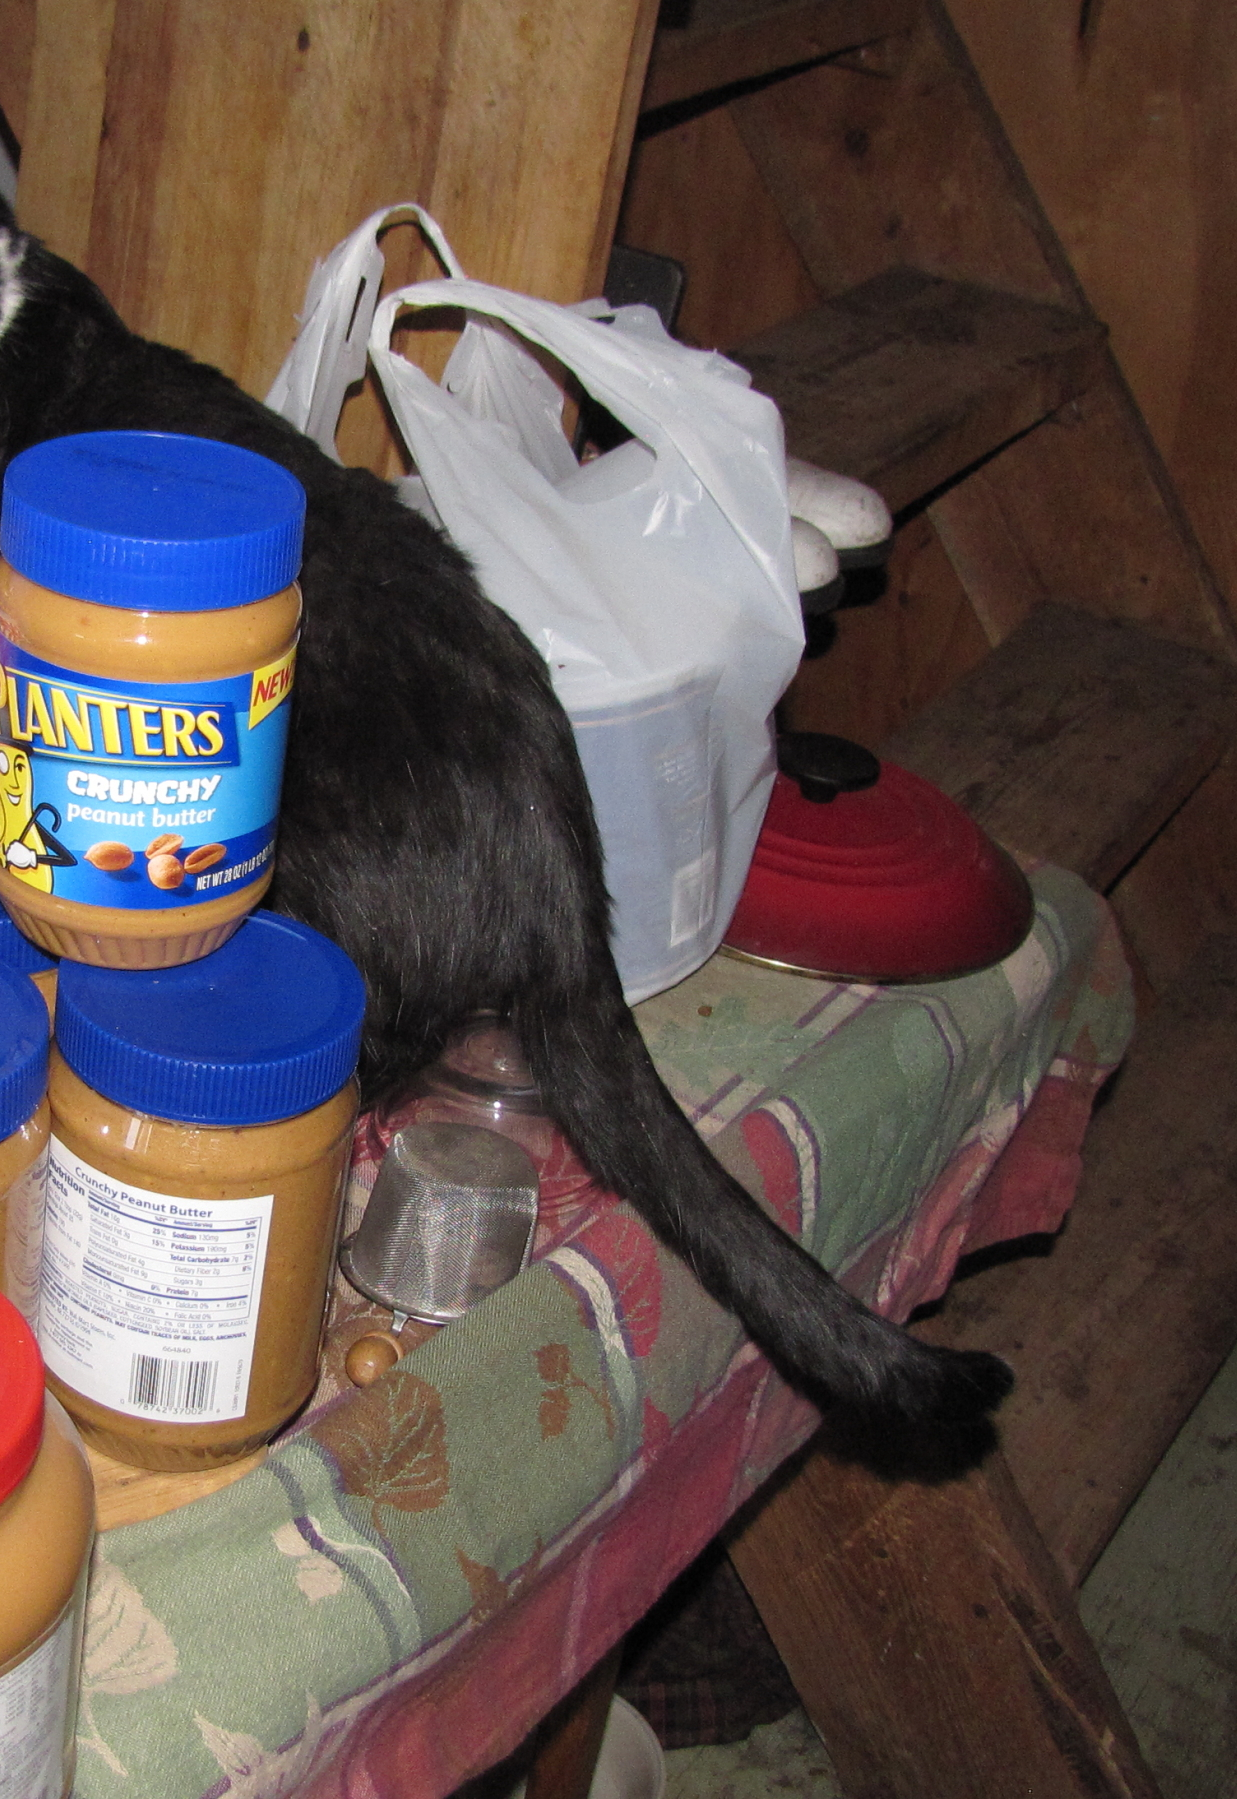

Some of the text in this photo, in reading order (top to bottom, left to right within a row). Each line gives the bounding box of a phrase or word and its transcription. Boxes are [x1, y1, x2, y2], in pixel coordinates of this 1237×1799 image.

[67, 770, 222, 805] CRUNCHY
[67, 802, 216, 827] peanut butter
[196, 874, 212, 891] NET
[212, 871, 224, 887] WT
[223, 868, 232, 883] 28
[233, 864, 242, 880] OZ
[48, 1169, 68, 1197] Facts
[49, 1156, 85, 1196] Nutrition
[75, 1167, 118, 1198] Crunchy
[121, 1192, 166, 1212] Peanut
